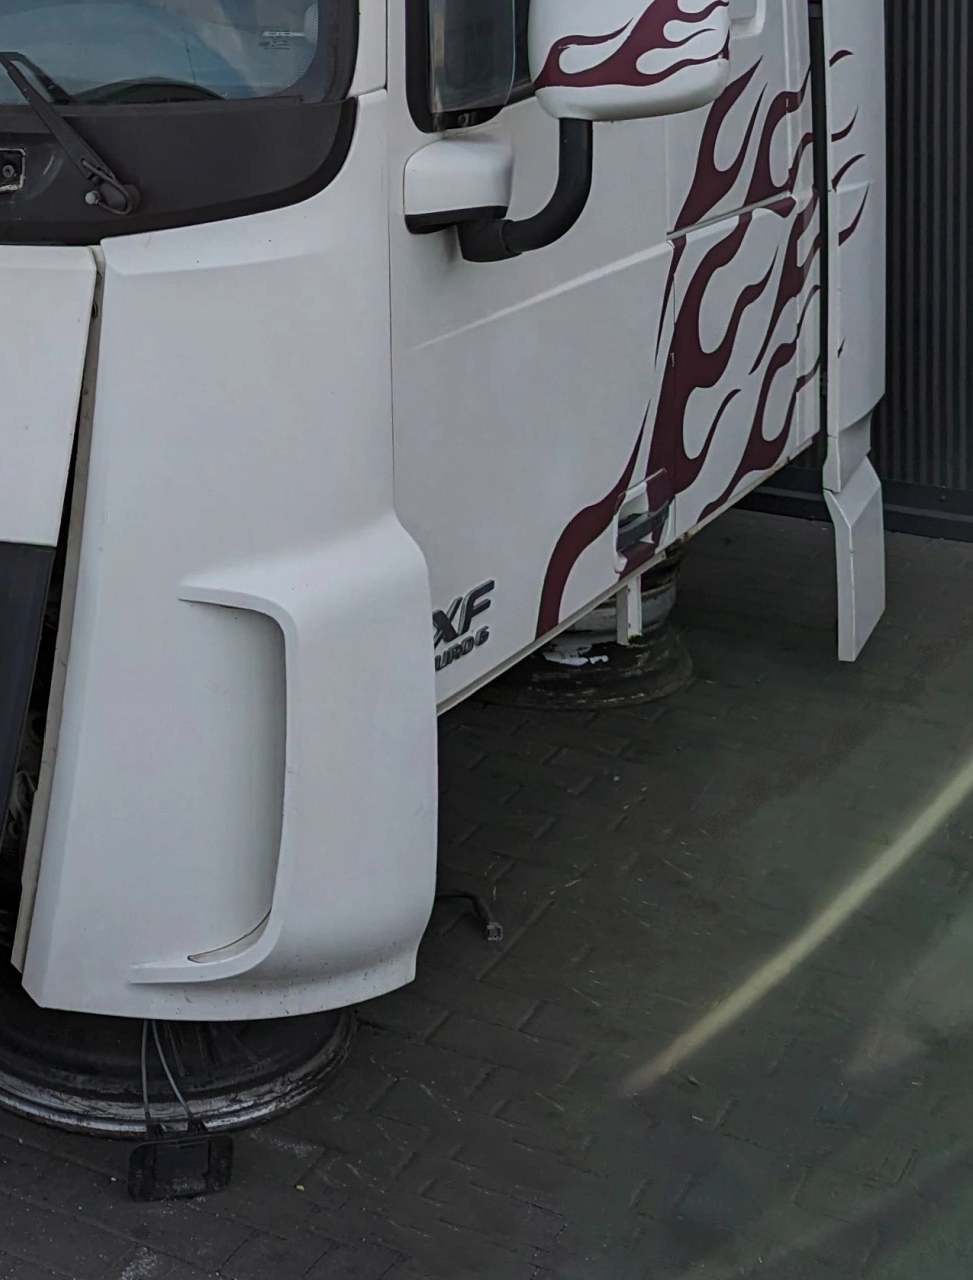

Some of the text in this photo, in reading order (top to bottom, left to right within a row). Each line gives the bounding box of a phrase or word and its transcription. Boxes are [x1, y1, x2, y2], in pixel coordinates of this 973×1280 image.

[432, 579, 495, 649] XF
[435, 625, 490, 672] URO 6
